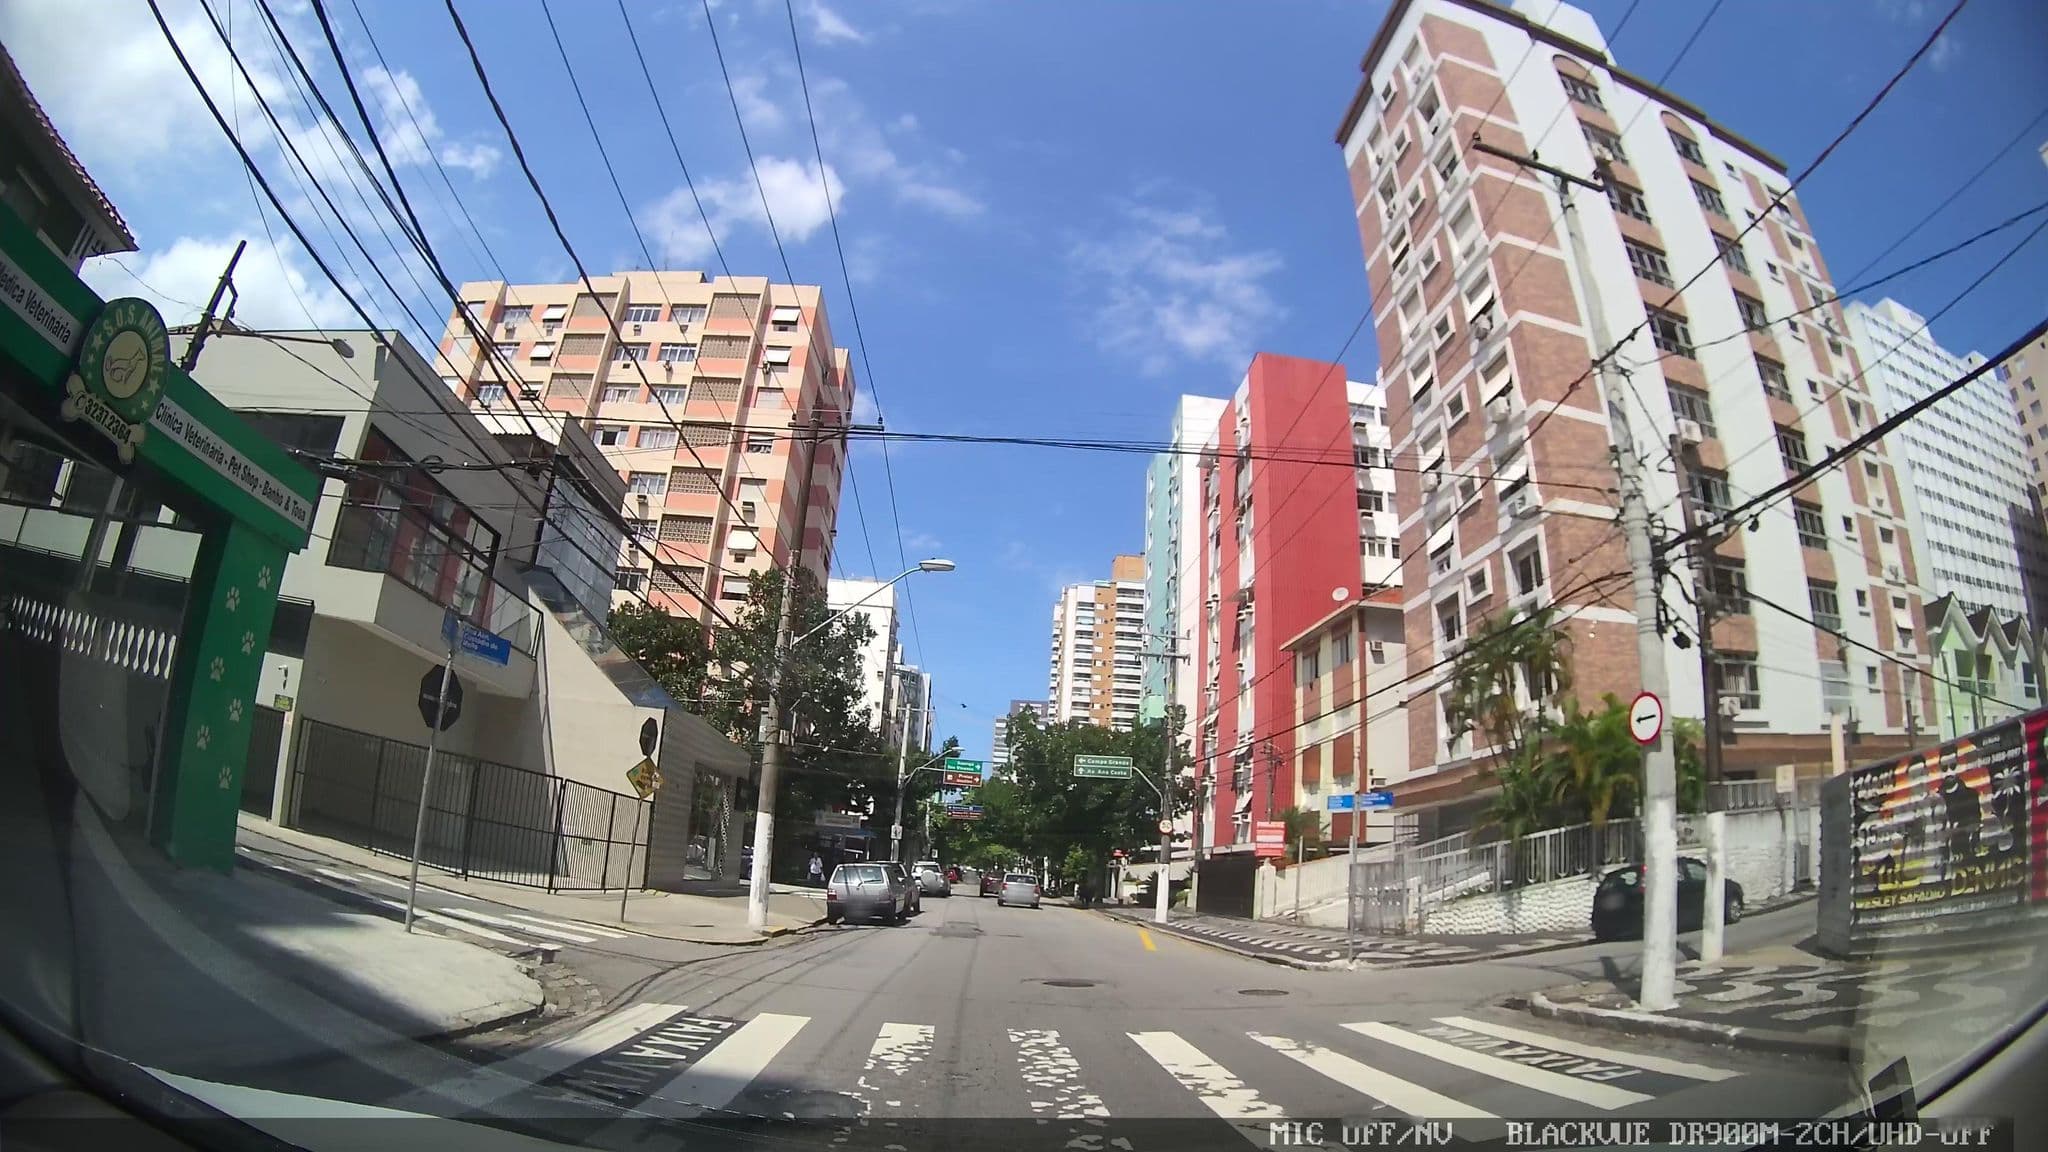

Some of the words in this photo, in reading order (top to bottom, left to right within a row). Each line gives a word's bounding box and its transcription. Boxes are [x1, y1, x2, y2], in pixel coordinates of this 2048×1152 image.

[228, 455, 242, 478] Pet
[241, 464, 259, 493] Shop
[619, 1017, 737, 1060] FAIXA
[1496, 1046, 1642, 1081] FAIXA
